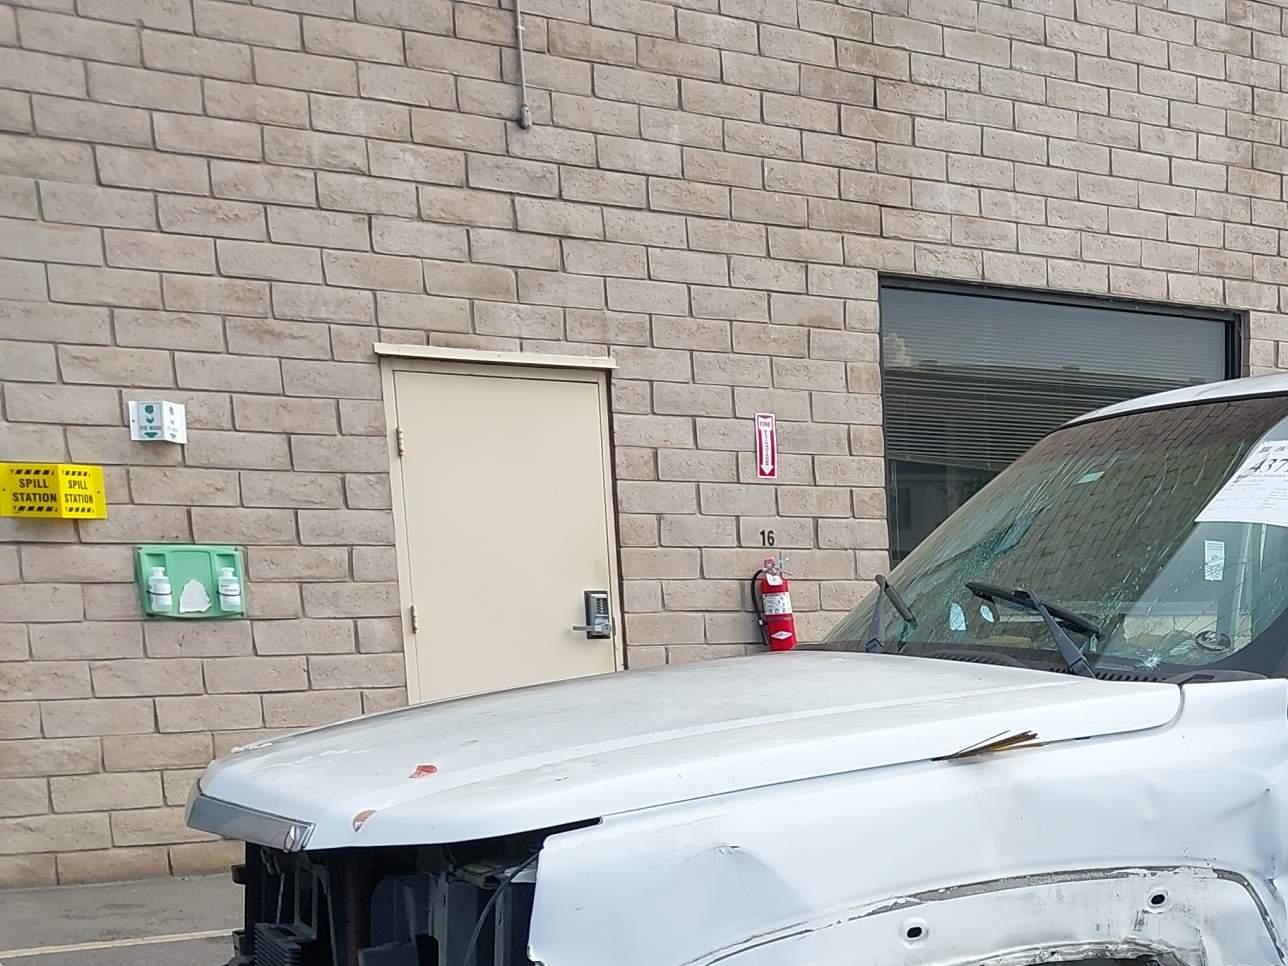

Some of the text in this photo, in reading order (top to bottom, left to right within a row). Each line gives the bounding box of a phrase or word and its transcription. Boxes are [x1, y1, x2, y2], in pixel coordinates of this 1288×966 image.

[19, 478, 49, 488] SPILL
[68, 479, 88, 490] SPILL
[12, 492, 57, 502] STATION
[64, 493, 93, 504] STATION
[760, 529, 774, 546] 16
